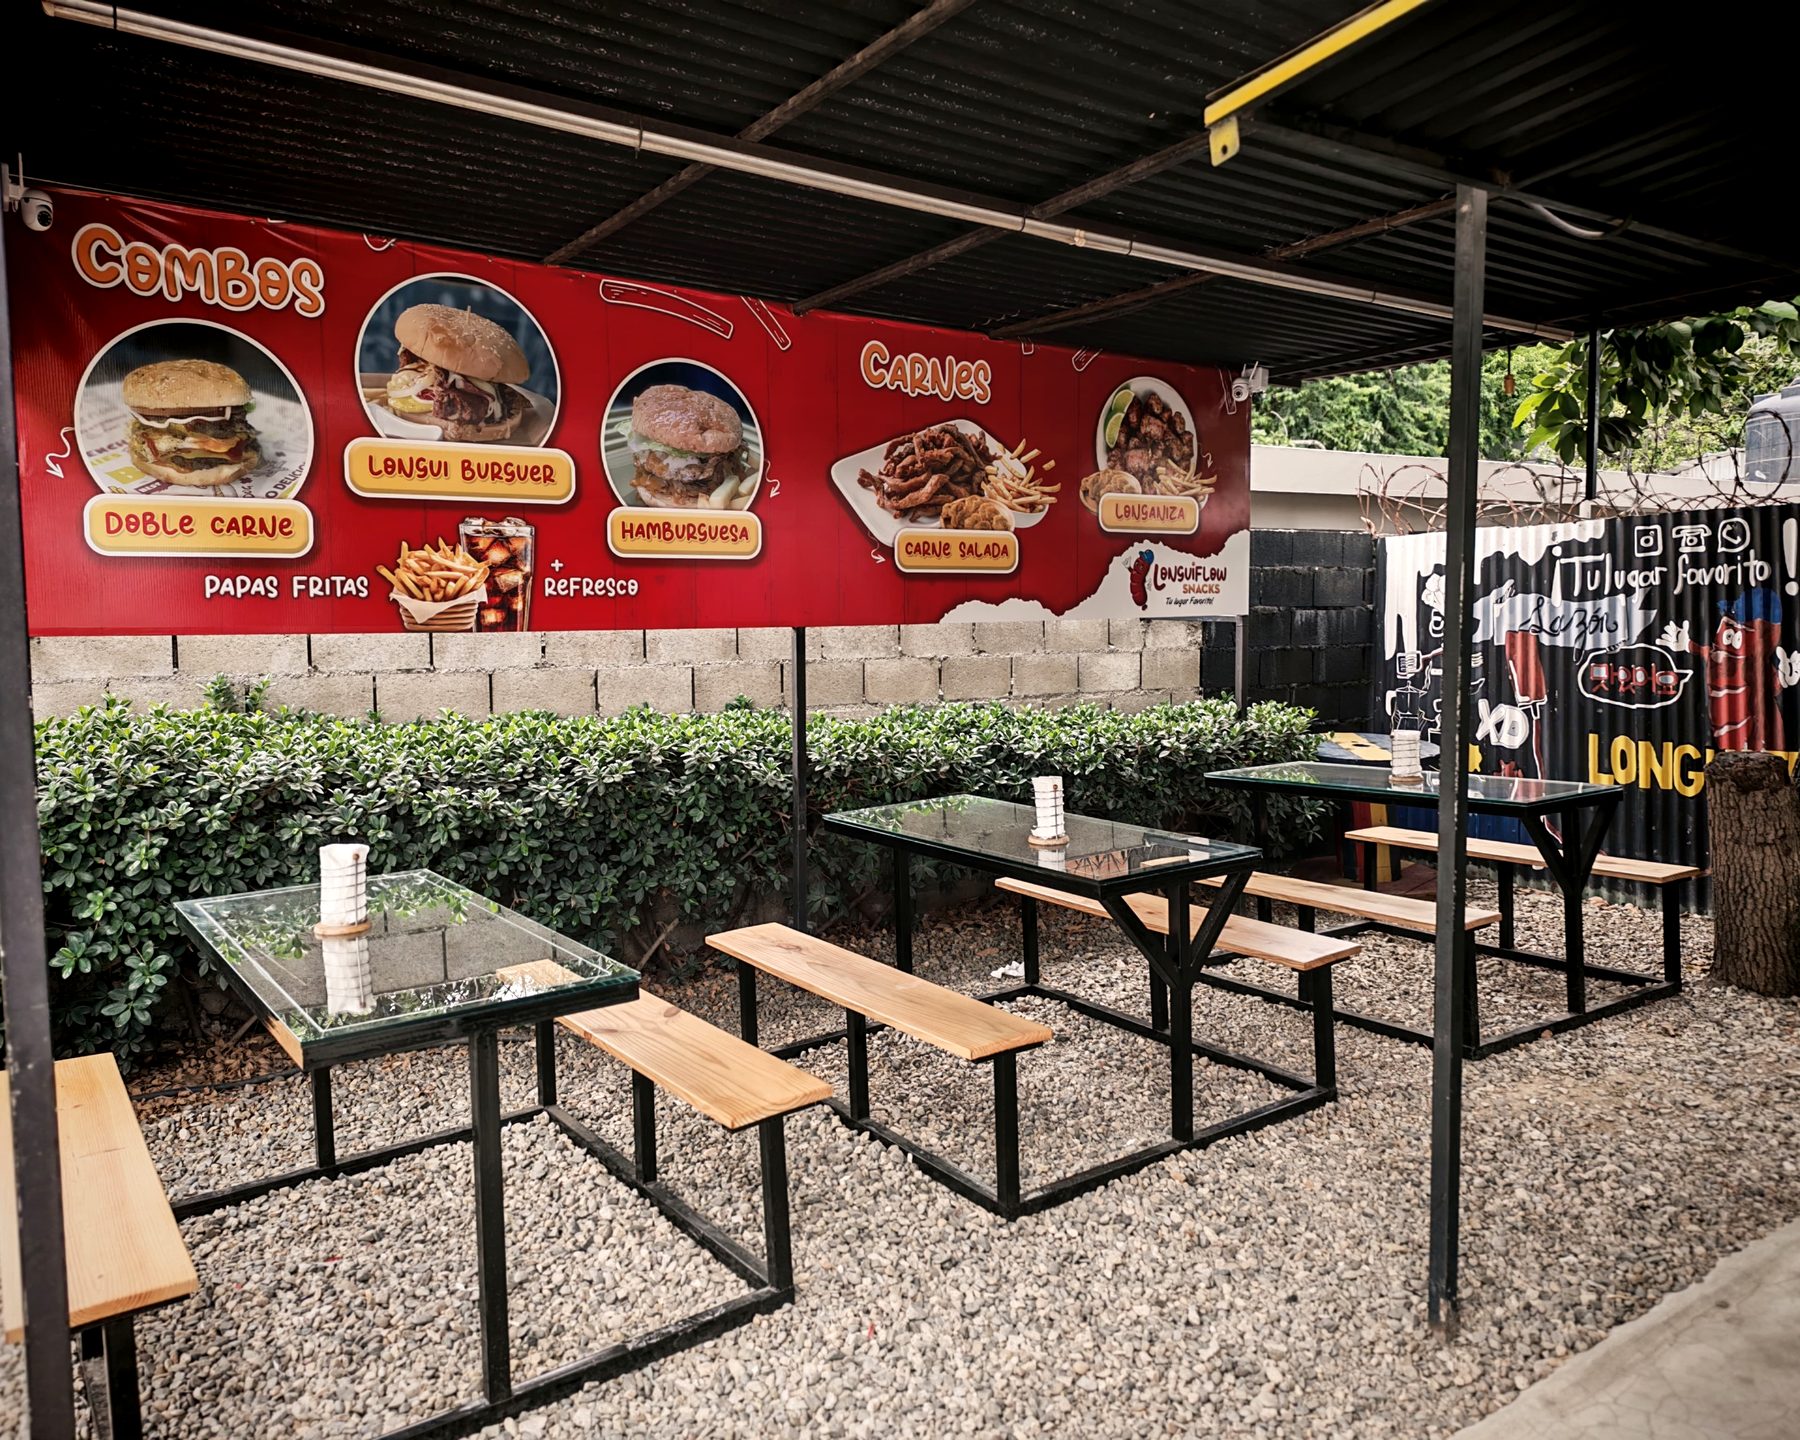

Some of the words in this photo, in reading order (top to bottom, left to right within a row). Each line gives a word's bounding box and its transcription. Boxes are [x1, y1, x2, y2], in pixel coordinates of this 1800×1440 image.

[71, 223, 325, 317] COMBOS
[368, 454, 449, 479] LONGUI
[1115, 503, 1185, 521] LONGANIZA
[959, 541, 1009, 559] SALADA
[204, 575, 278, 599] PAPAS
[292, 576, 369, 598] FRITAS
[1182, 583, 1221, 594] SNACKS
